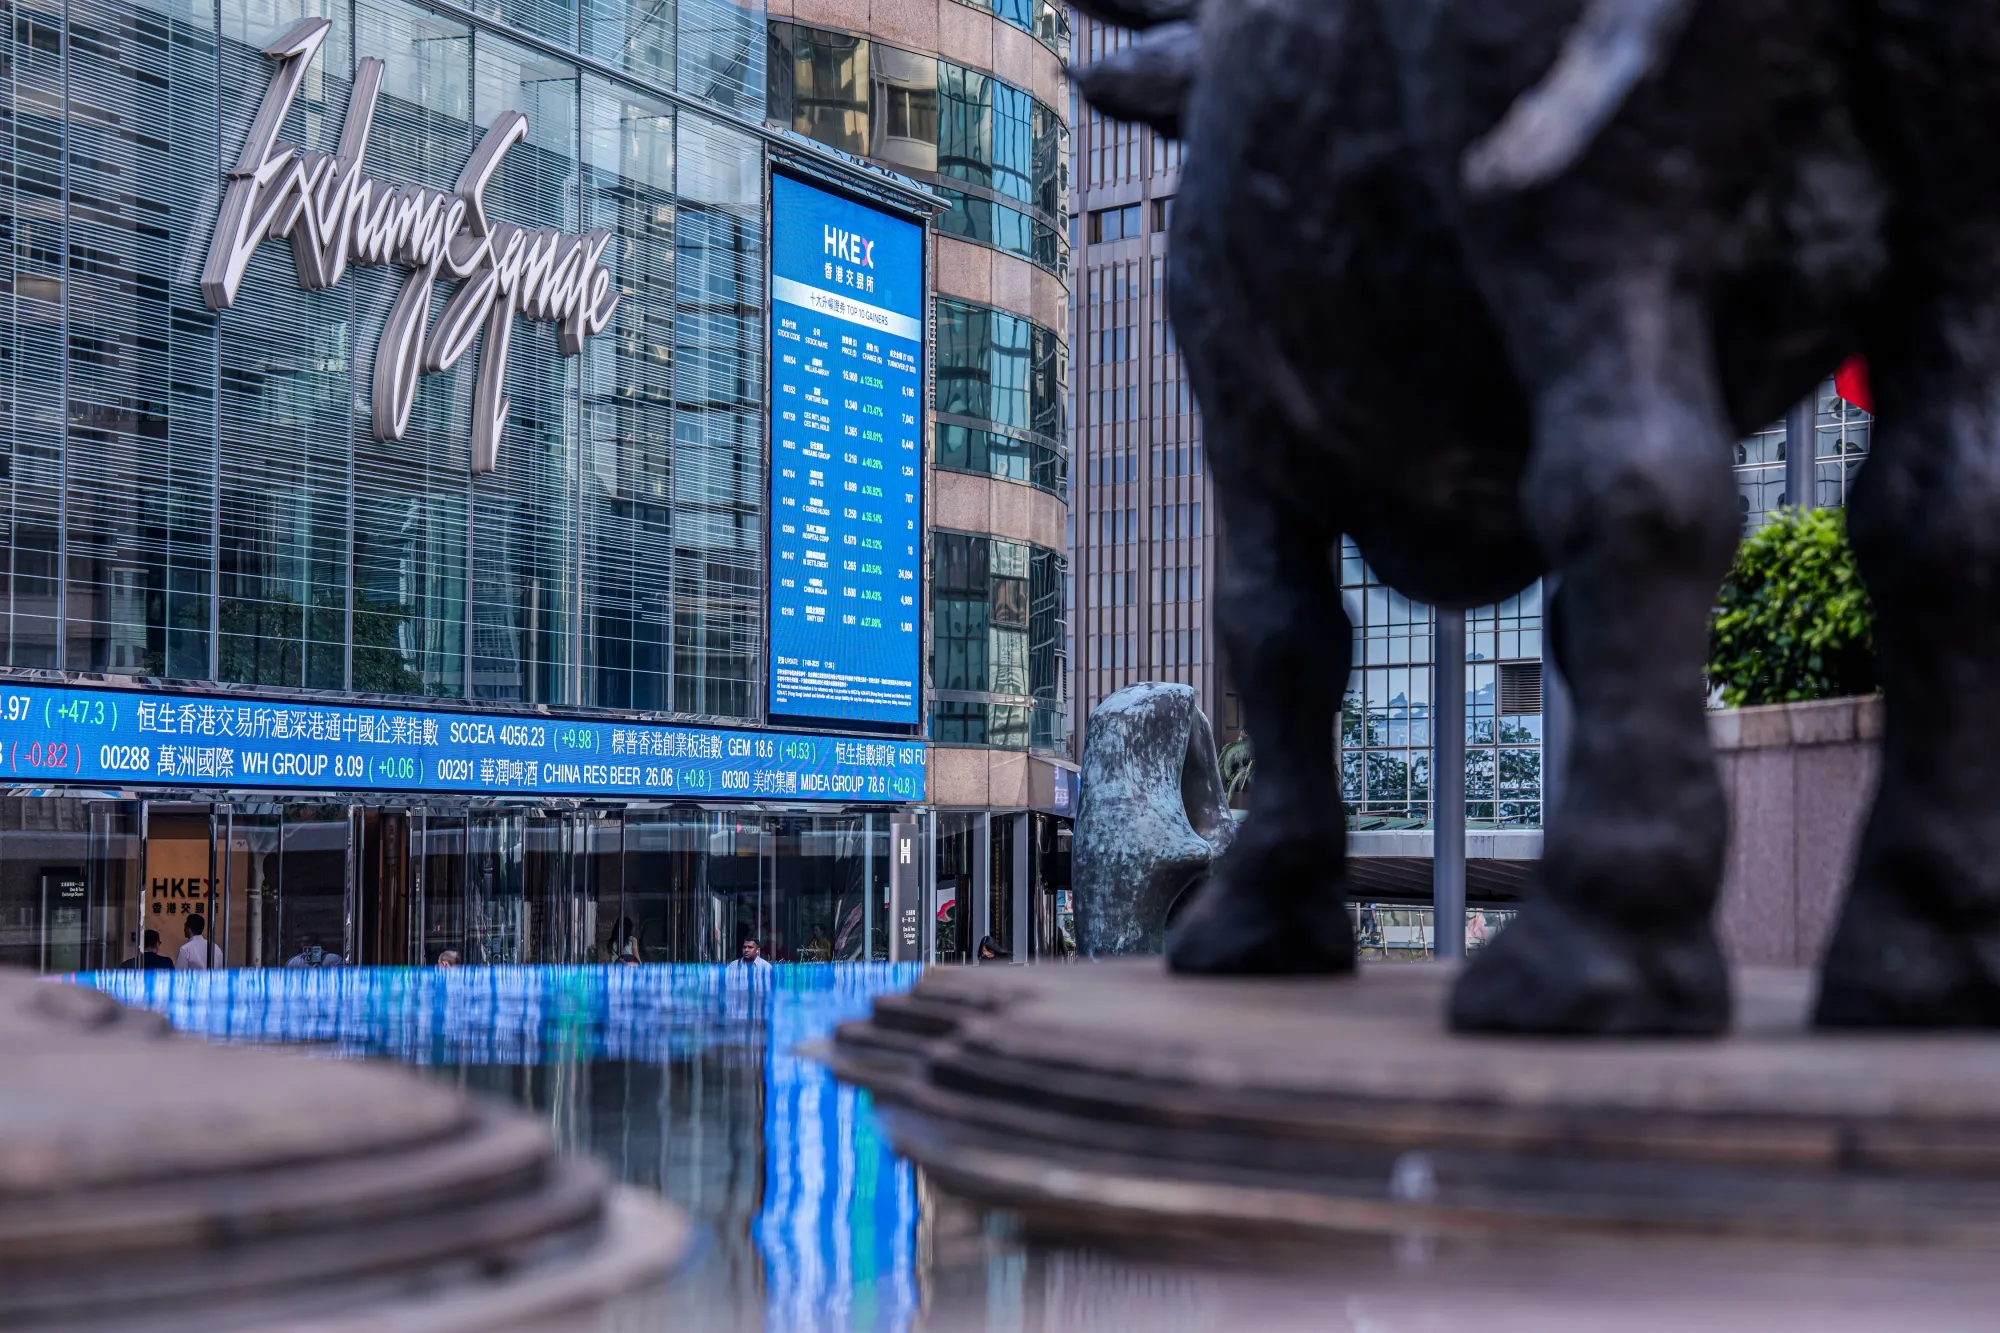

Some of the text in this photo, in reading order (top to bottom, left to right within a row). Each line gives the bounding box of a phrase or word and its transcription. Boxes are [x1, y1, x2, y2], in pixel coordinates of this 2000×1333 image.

[201, 16, 621, 475] Exchange Square
[824, 224, 874, 269] HKEX
[824, 262, 874, 293] 香港交易所
[847, 305, 858, 316] TOP
[859, 309, 866, 319] 10
[866, 311, 888, 326] GAINERS
[777, 329, 801, 341] STOCK CODE
[805, 336, 817, 346] STOCK
[842, 346, 852, 356] PRICE
[862, 352, 876, 363] CHANGE
[887, 360, 905, 371] TURNOVER
[136, 700, 439, 747] 恒生香港交易所滬深港通中國企業指數
[450, 722, 496, 744] SCCEA
[499, 725, 545, 747] 4056.23
[611, 728, 722, 759] 標普香港創業板指數
[728, 738, 751, 757] GEM
[754, 739, 773, 758] 18.6
[835, 741, 896, 768] 恒生指數期貨
[899, 747, 914, 765] HSI
[100, 744, 150, 771] 00288
[156, 744, 235, 779] 萬洲國際
[241, 751, 269, 775] WH
[271, 752, 329, 777] GROUP
[334, 754, 364, 778] 8.09
[437, 758, 474, 781] 00291
[480, 757, 538, 787] 華潤啤酒
[543, 763, 581, 784] CHINA
[583, 764, 608, 785] RES
[609, 766, 641, 786] BEER
[645, 766, 673, 788] 26.06
[721, 770, 750, 789] 00300
[752, 769, 797, 795] 美的集團
[800, 773, 831, 792] MIDEA
[831, 774, 864, 793] GROUP
[867, 776, 885, 794] 78.6
[152, 902, 219, 914] 香港交易
